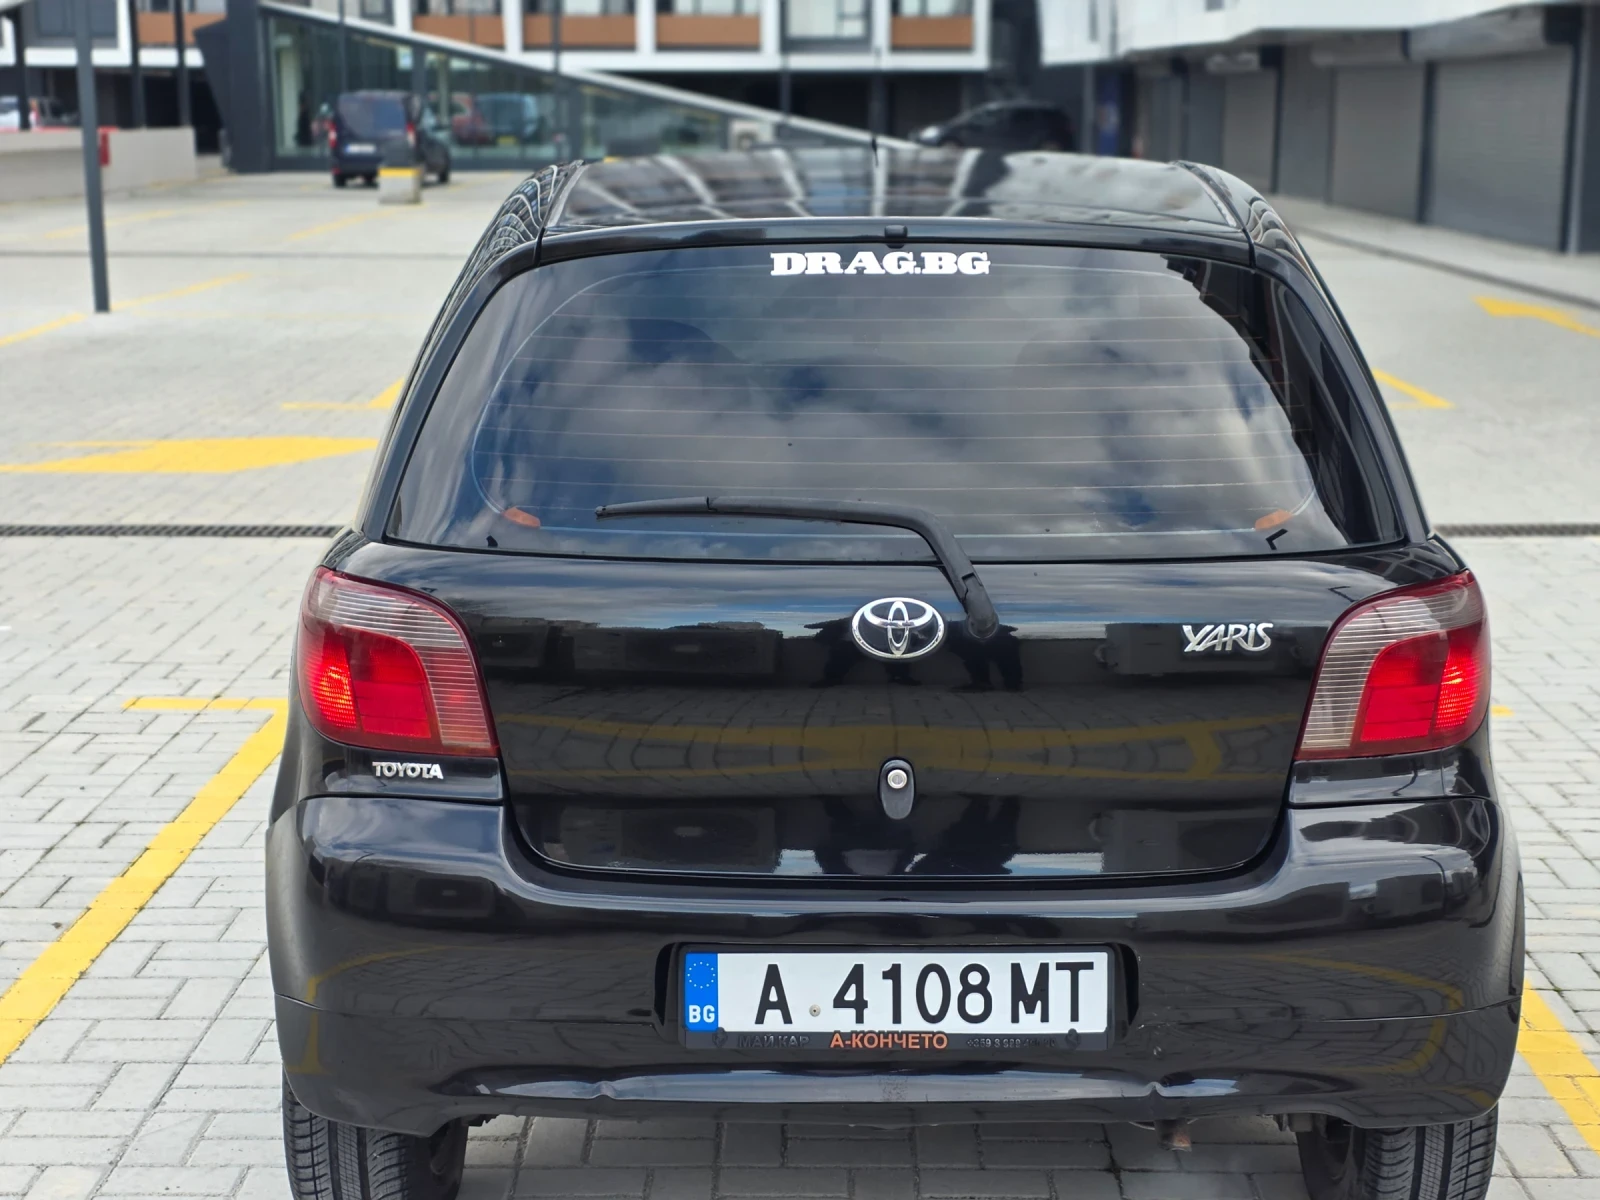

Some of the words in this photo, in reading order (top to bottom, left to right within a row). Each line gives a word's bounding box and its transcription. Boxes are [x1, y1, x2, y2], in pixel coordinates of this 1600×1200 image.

[770, 251, 991, 276] DRAG.BG
[372, 761, 444, 779] TOYOTA
[754, 963, 793, 1025] A
[832, 962, 993, 1025] 4108
[1010, 961, 1095, 1024] MT
[688, 1004, 716, 1023] BG
[829, 1032, 949, 1049] А-КОНЧЕТО
